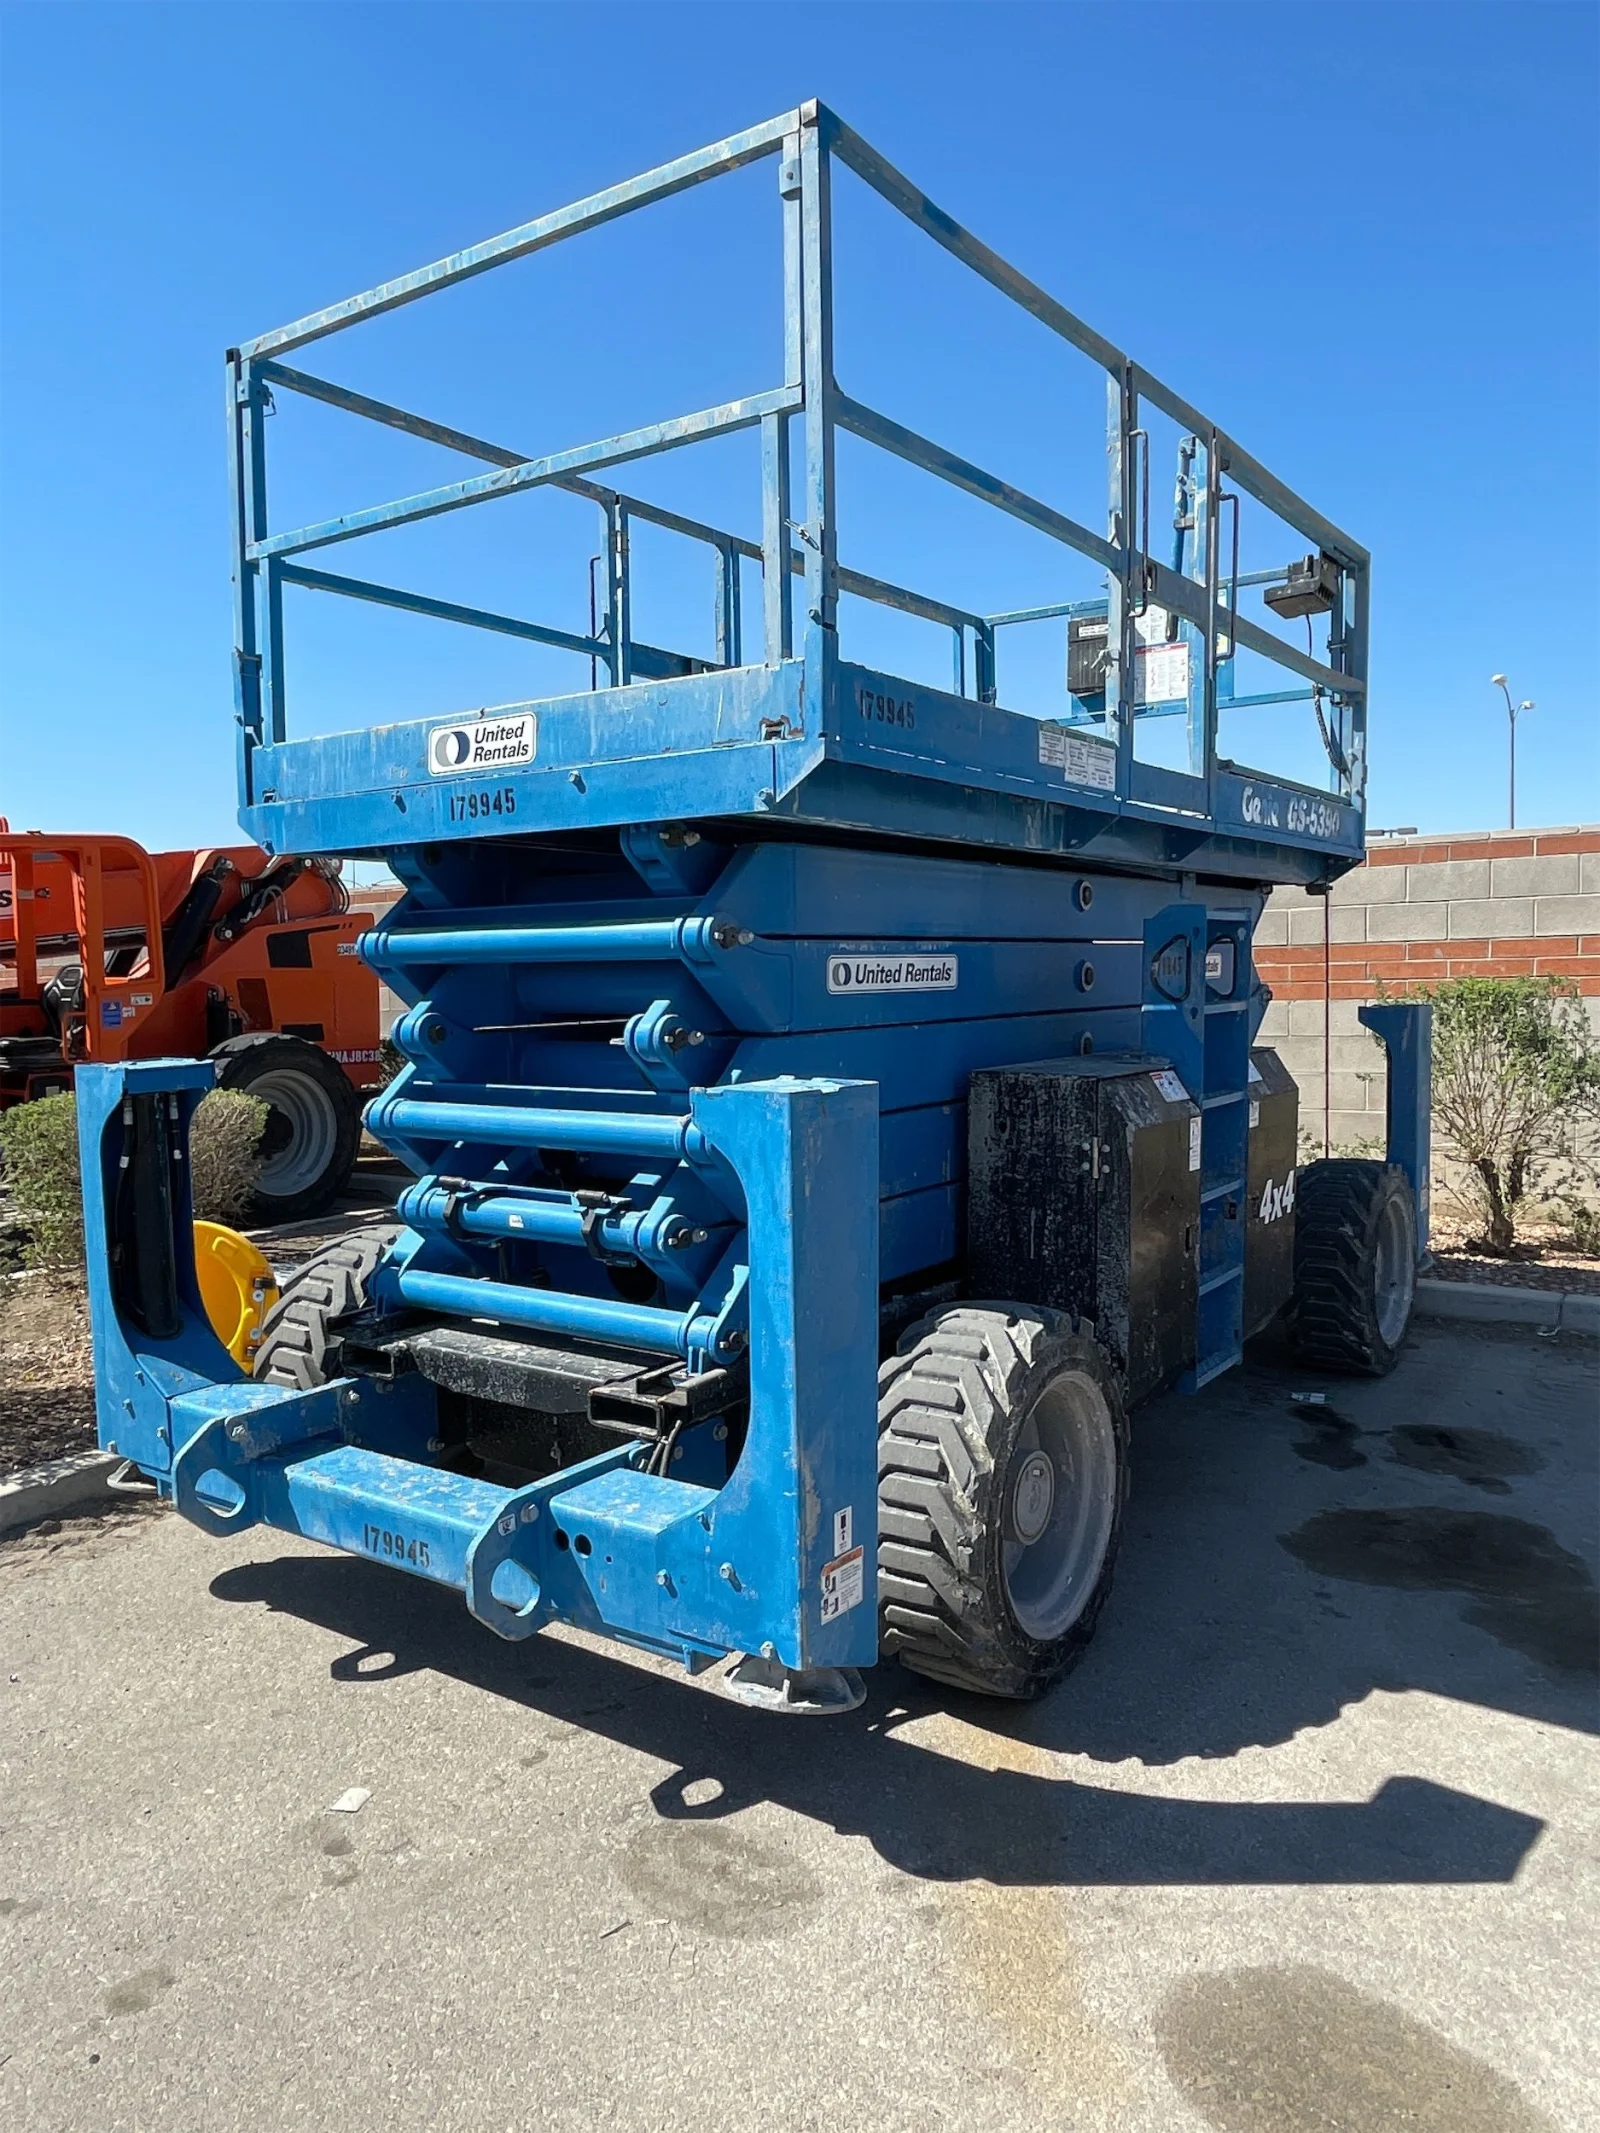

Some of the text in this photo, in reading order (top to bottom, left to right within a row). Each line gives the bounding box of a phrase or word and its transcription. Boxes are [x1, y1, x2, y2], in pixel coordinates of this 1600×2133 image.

[860, 690, 915, 730] 179945
[474, 721, 526, 744] United
[473, 741, 529, 763] Rentals
[450, 788, 516, 821] 179945
[855, 962, 952, 984] United Rentals
[1259, 1170, 1295, 1225] 4x4
[364, 1523, 430, 1568] 179945
